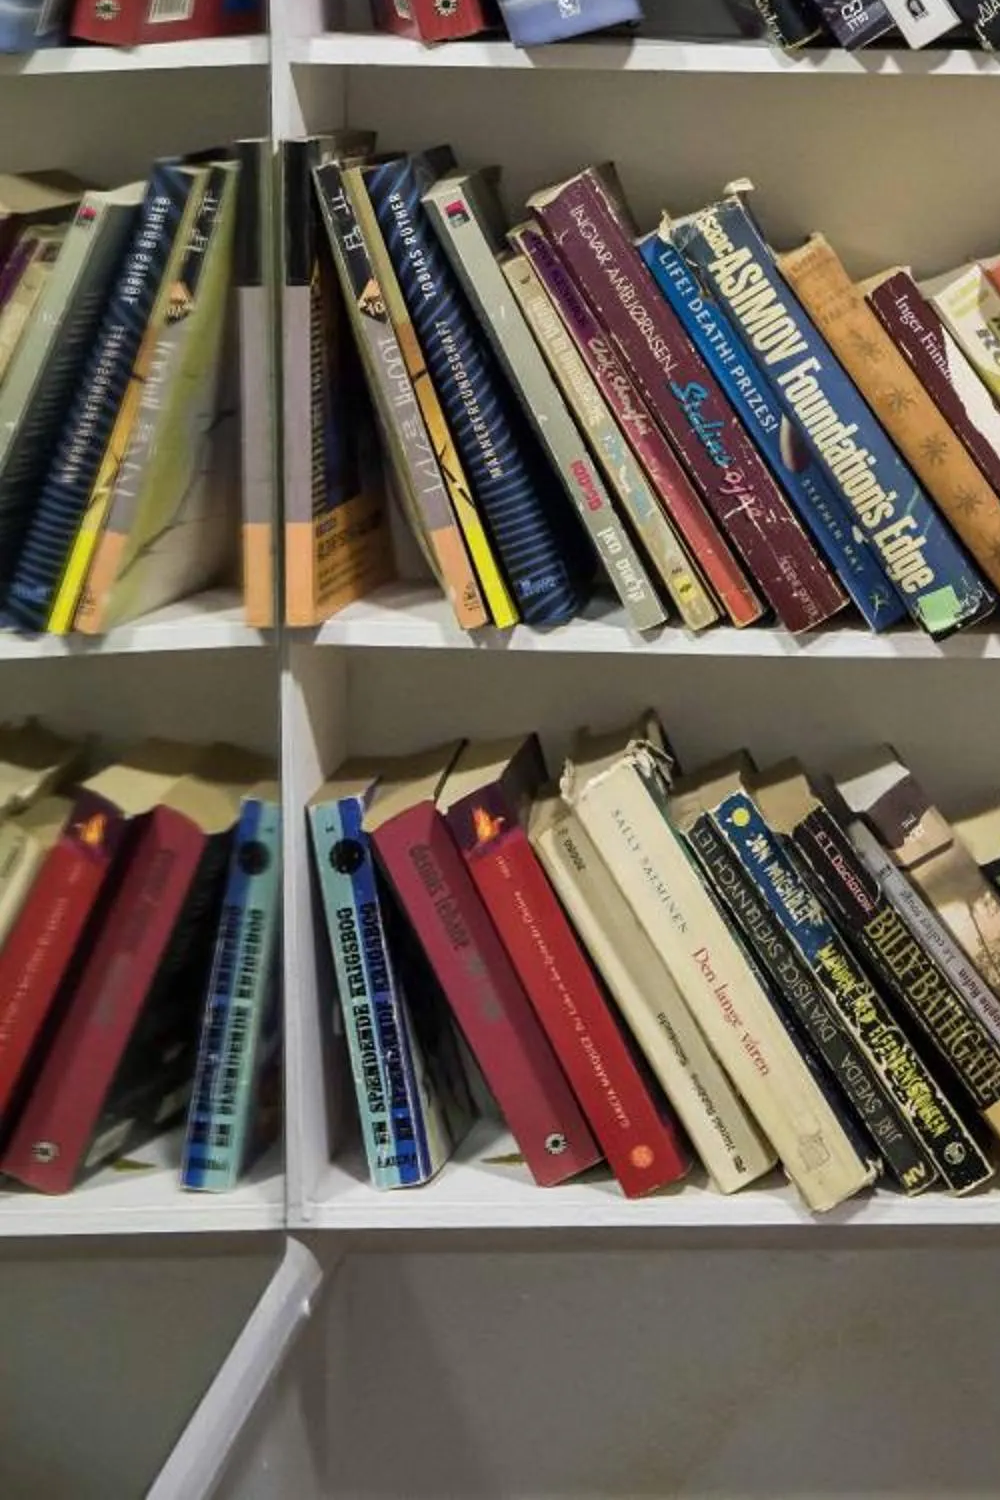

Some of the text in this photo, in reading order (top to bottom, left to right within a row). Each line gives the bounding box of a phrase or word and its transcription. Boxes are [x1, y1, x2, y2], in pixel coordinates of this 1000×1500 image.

[691, 206, 739, 262] Isaac
[405, 245, 441, 301] TOBIAS
[566, 202, 617, 269] INGVAR
[601, 261, 682, 375] AMBJØRNSEN
[705, 240, 811, 373] ASIMOV
[888, 293, 927, 338] Inger
[655, 247, 782, 435] LIFE! DEATH! PRIZES!
[772, 353, 906, 534] Foundation's
[838, 542, 868, 575] MAY
[865, 510, 947, 600] Edge
[607, 806, 643, 853] SALLY
[336, 905, 371, 997] KRIGSBOG
[689, 944, 723, 984] Den
[860, 904, 930, 981] BILLY
[803, 1001, 839, 1043] DVA
